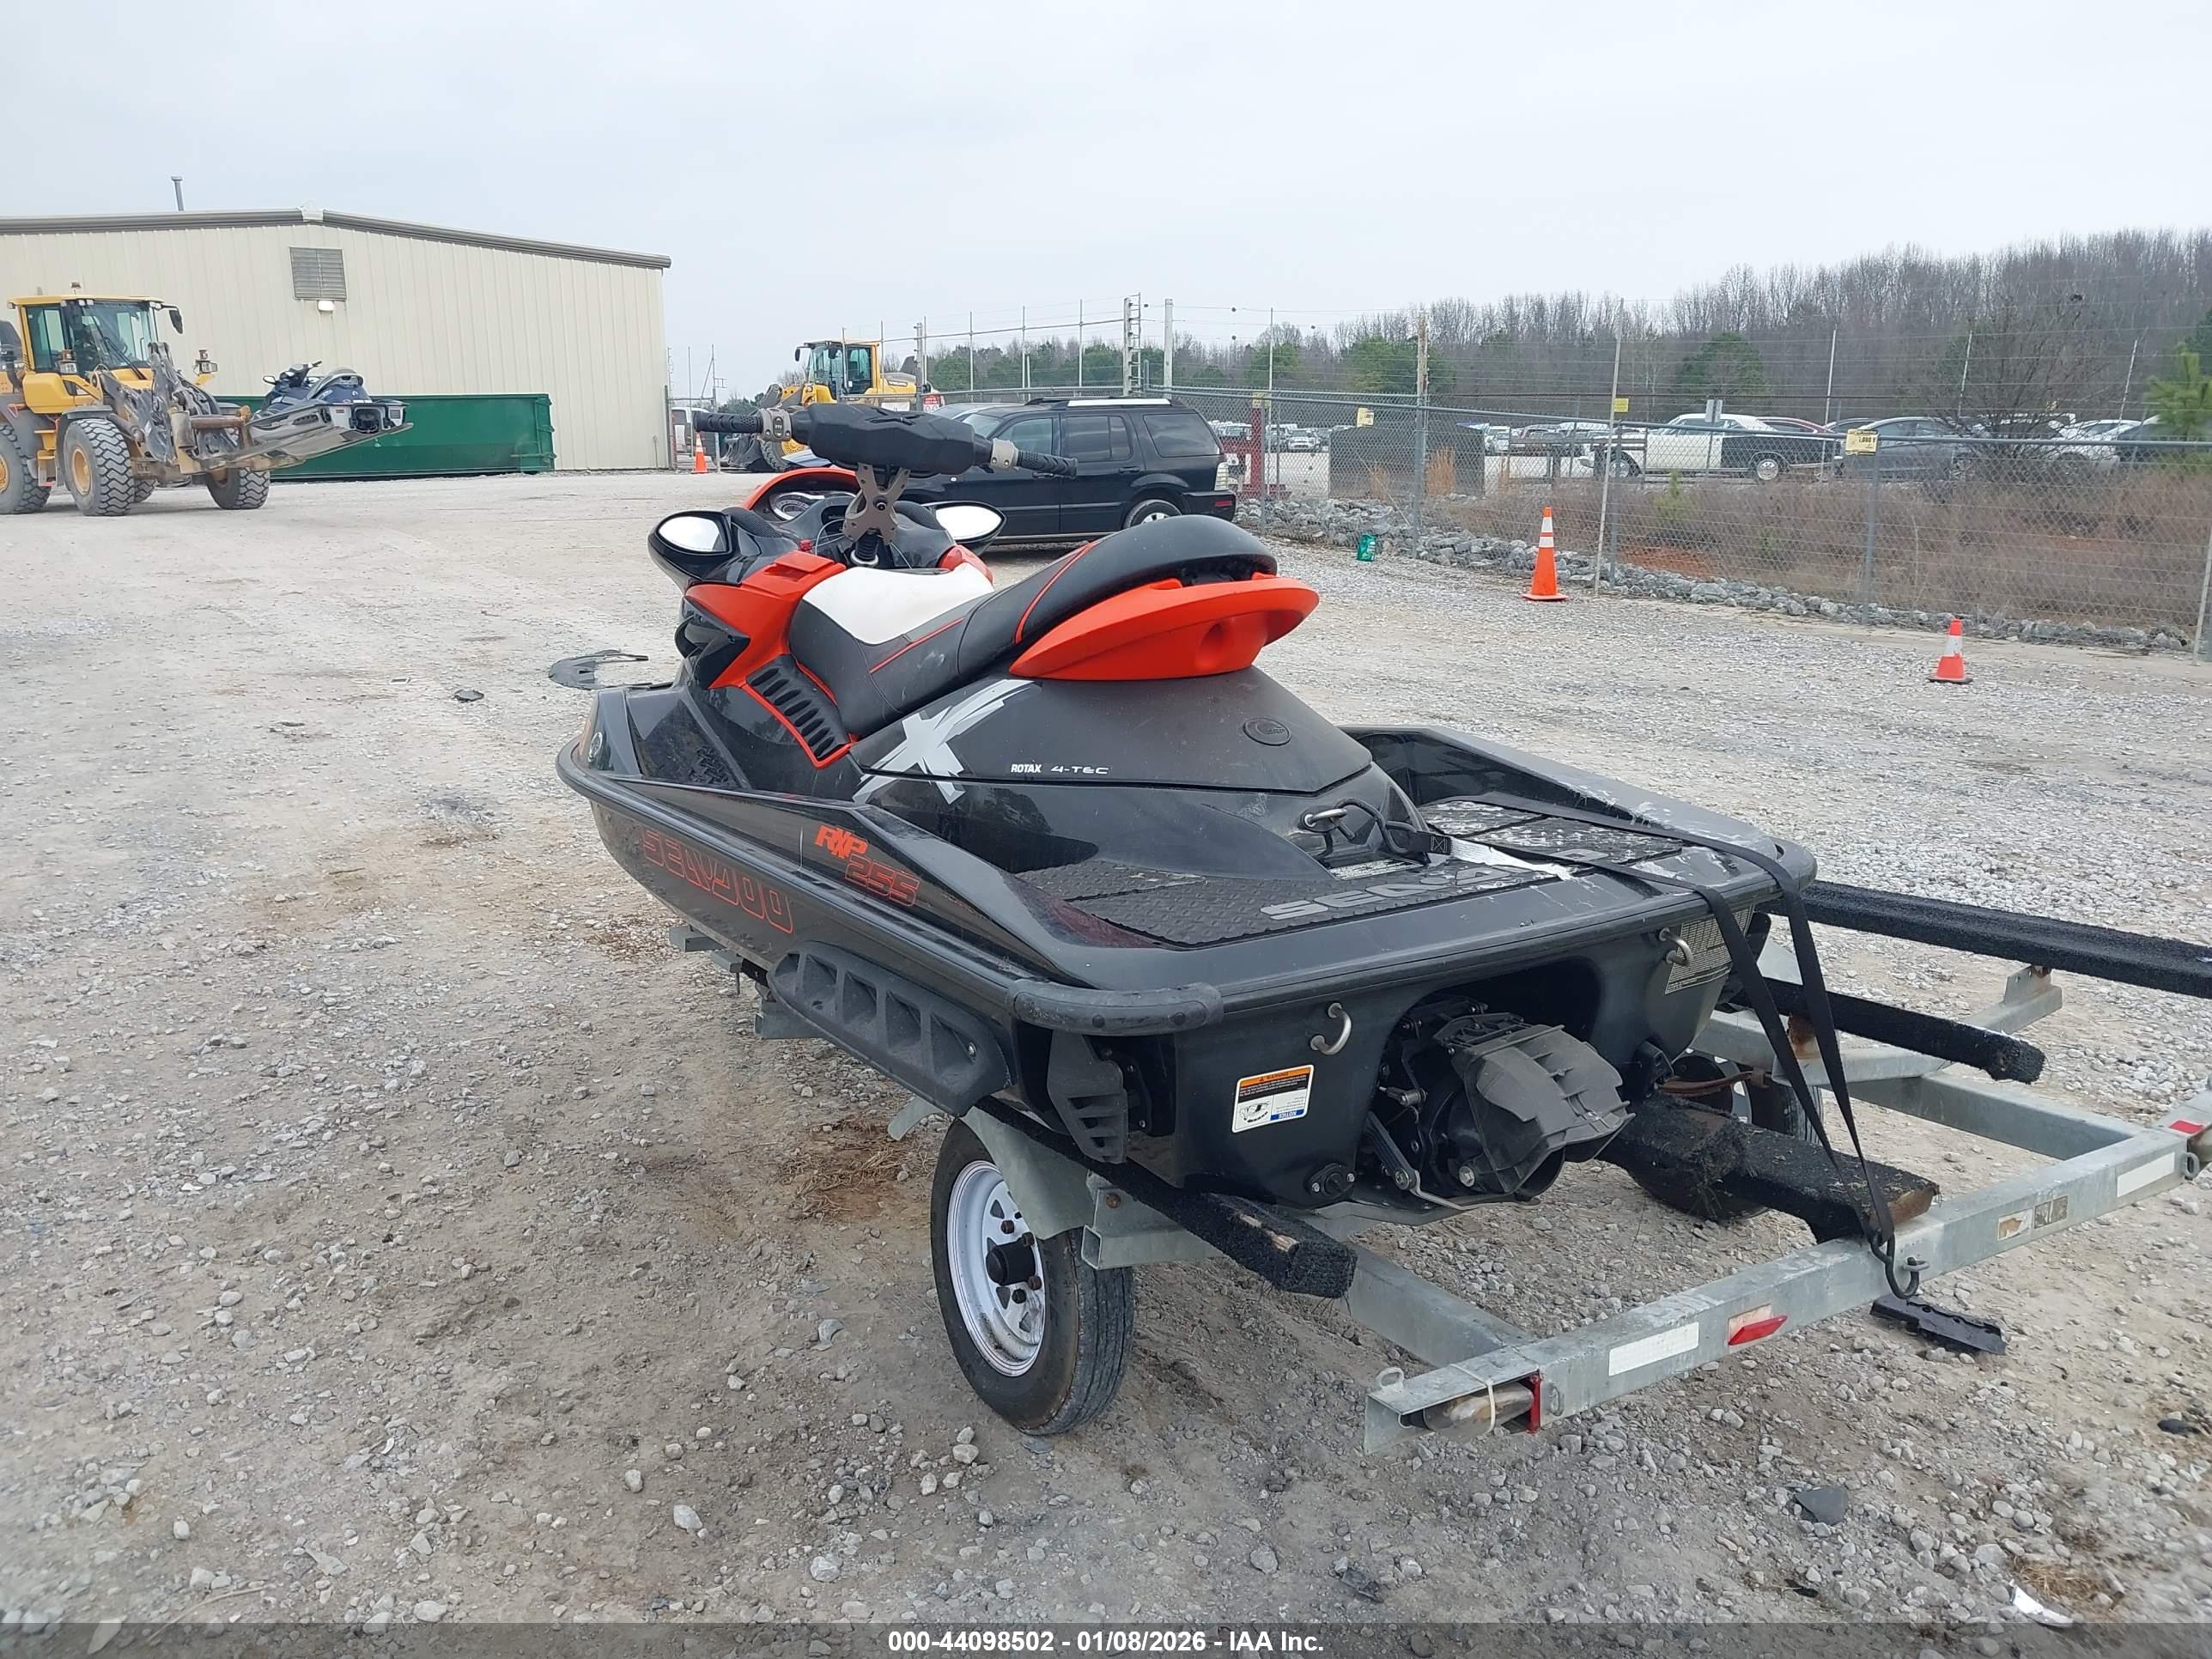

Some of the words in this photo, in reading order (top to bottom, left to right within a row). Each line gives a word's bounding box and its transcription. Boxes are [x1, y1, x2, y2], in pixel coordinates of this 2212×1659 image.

[1011, 764, 1042, 774] ROTAX
[1050, 766, 1109, 775] 4-TEC
[816, 824, 868, 859] RXP
[845, 854, 921, 907] 255
